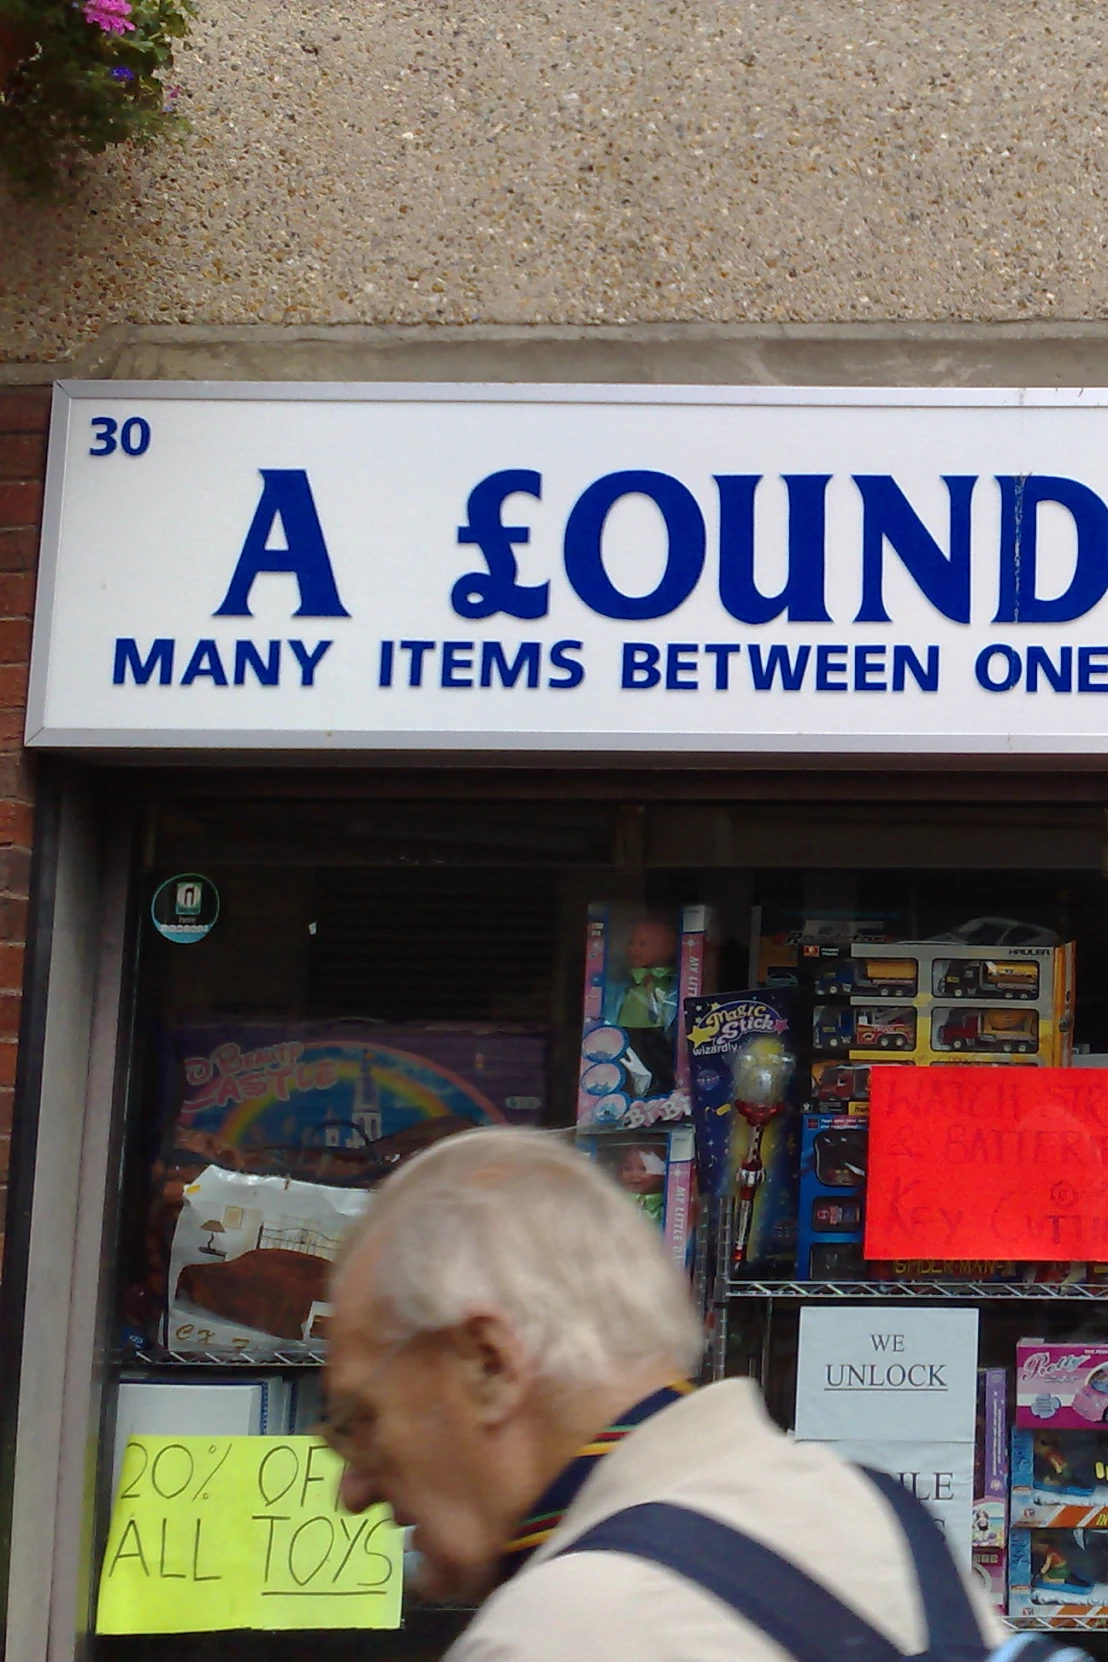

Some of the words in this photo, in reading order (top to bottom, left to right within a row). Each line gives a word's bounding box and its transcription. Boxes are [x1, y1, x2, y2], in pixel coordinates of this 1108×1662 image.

[89, 416, 151, 456] 30
[212, 468, 351, 617] A
[112, 637, 332, 687] MANY
[378, 639, 585, 690] ITEMS
[621, 642, 940, 692] BETWEEN
[1008, 948, 1051, 956] HAULER
[687, 975, 700, 998] LITT
[871, 1334, 906, 1352] WE
[825, 1364, 948, 1387] UNLOCK
[119, 1443, 232, 1501] 20%
[259, 1445, 345, 1511] OF
[109, 1517, 222, 1581] ALL
[252, 1515, 392, 1586] TOYS
